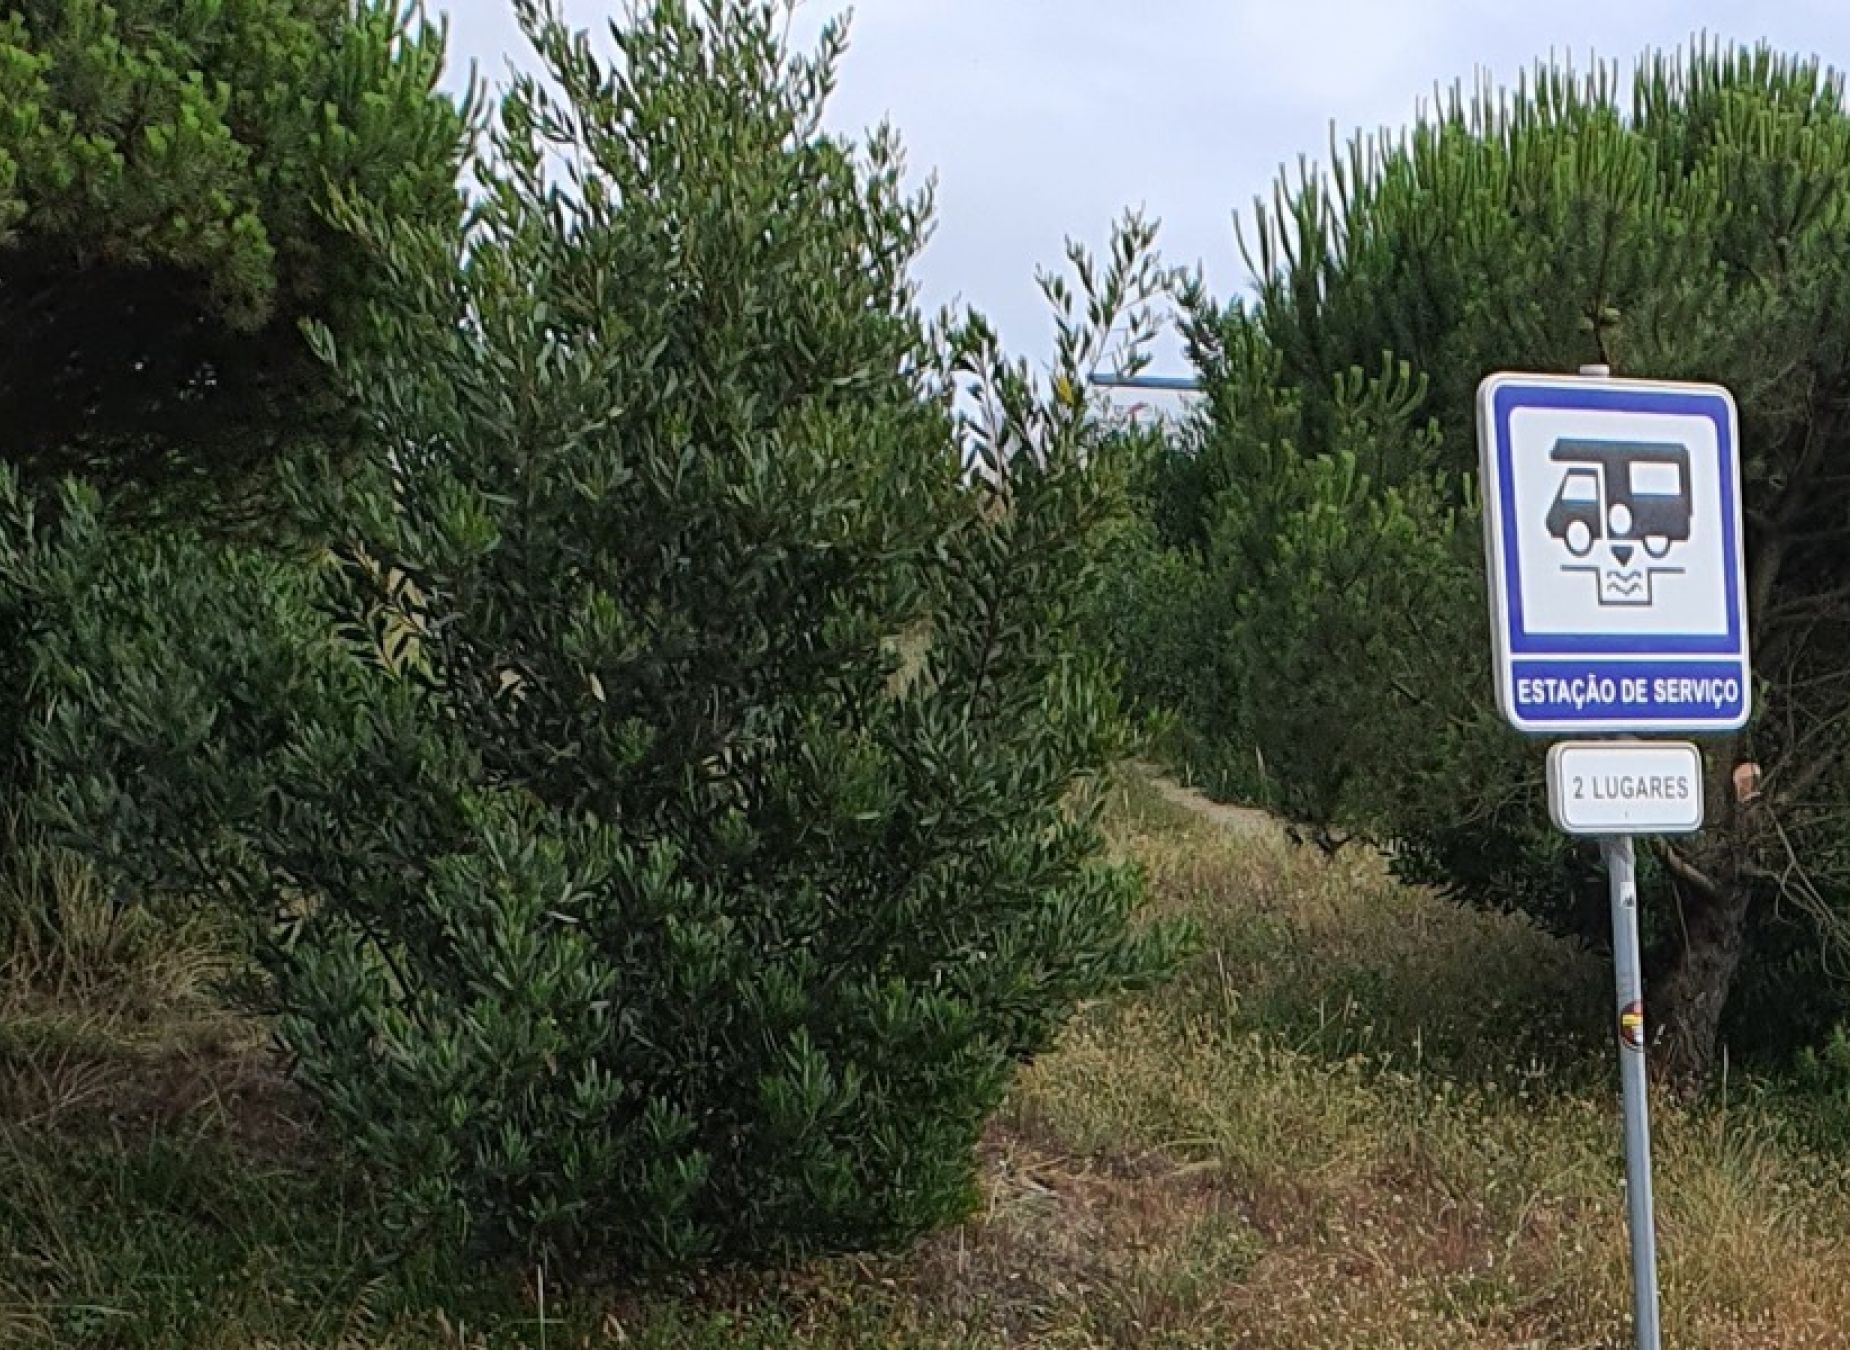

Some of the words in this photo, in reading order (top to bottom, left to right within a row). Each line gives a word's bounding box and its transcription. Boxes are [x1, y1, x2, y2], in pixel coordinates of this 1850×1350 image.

[1516, 672, 1617, 711] ESTAÇÃO
[1620, 678, 1649, 703] DE
[1653, 678, 1739, 710] SERVIÇO
[1572, 775, 1585, 800] 2
[1592, 775, 1690, 800] LUGARES
